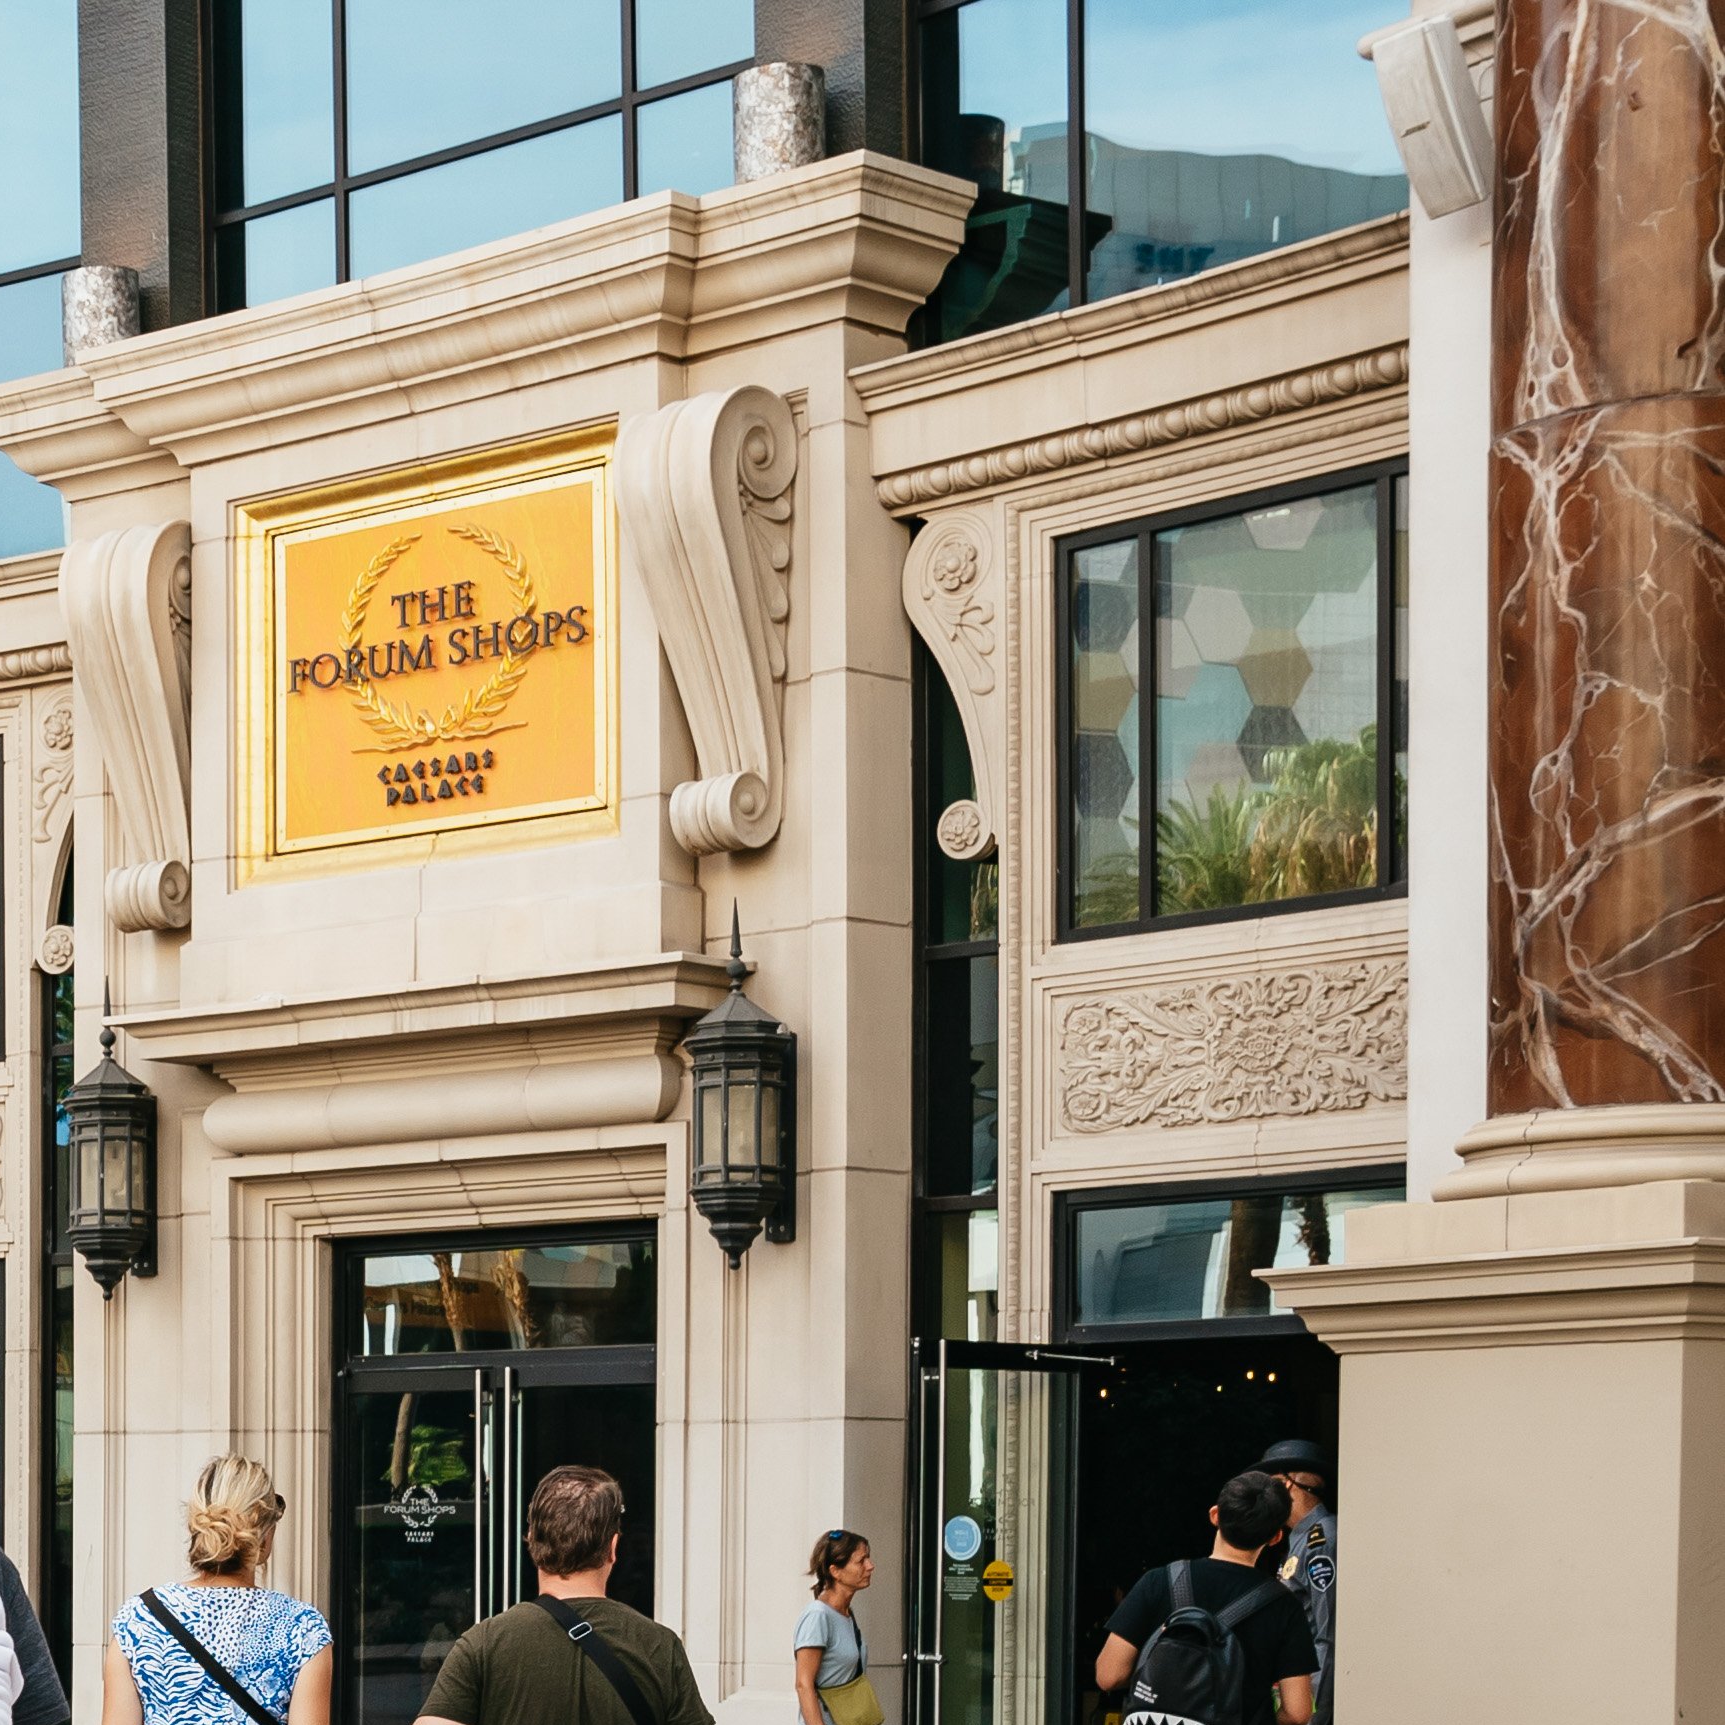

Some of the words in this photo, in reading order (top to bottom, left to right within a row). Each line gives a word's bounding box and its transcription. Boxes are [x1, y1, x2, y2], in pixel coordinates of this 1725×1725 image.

[391, 580, 476, 629] THE
[288, 634, 436, 694] FORUM
[448, 605, 589, 665] SHOPS
[377, 749, 497, 786] CAESARS
[386, 774, 485, 807] PALACE
[384, 1505, 419, 1514] FORUM
[421, 1505, 456, 1514] SHOPS
[410, 1498, 429, 1506] THE
